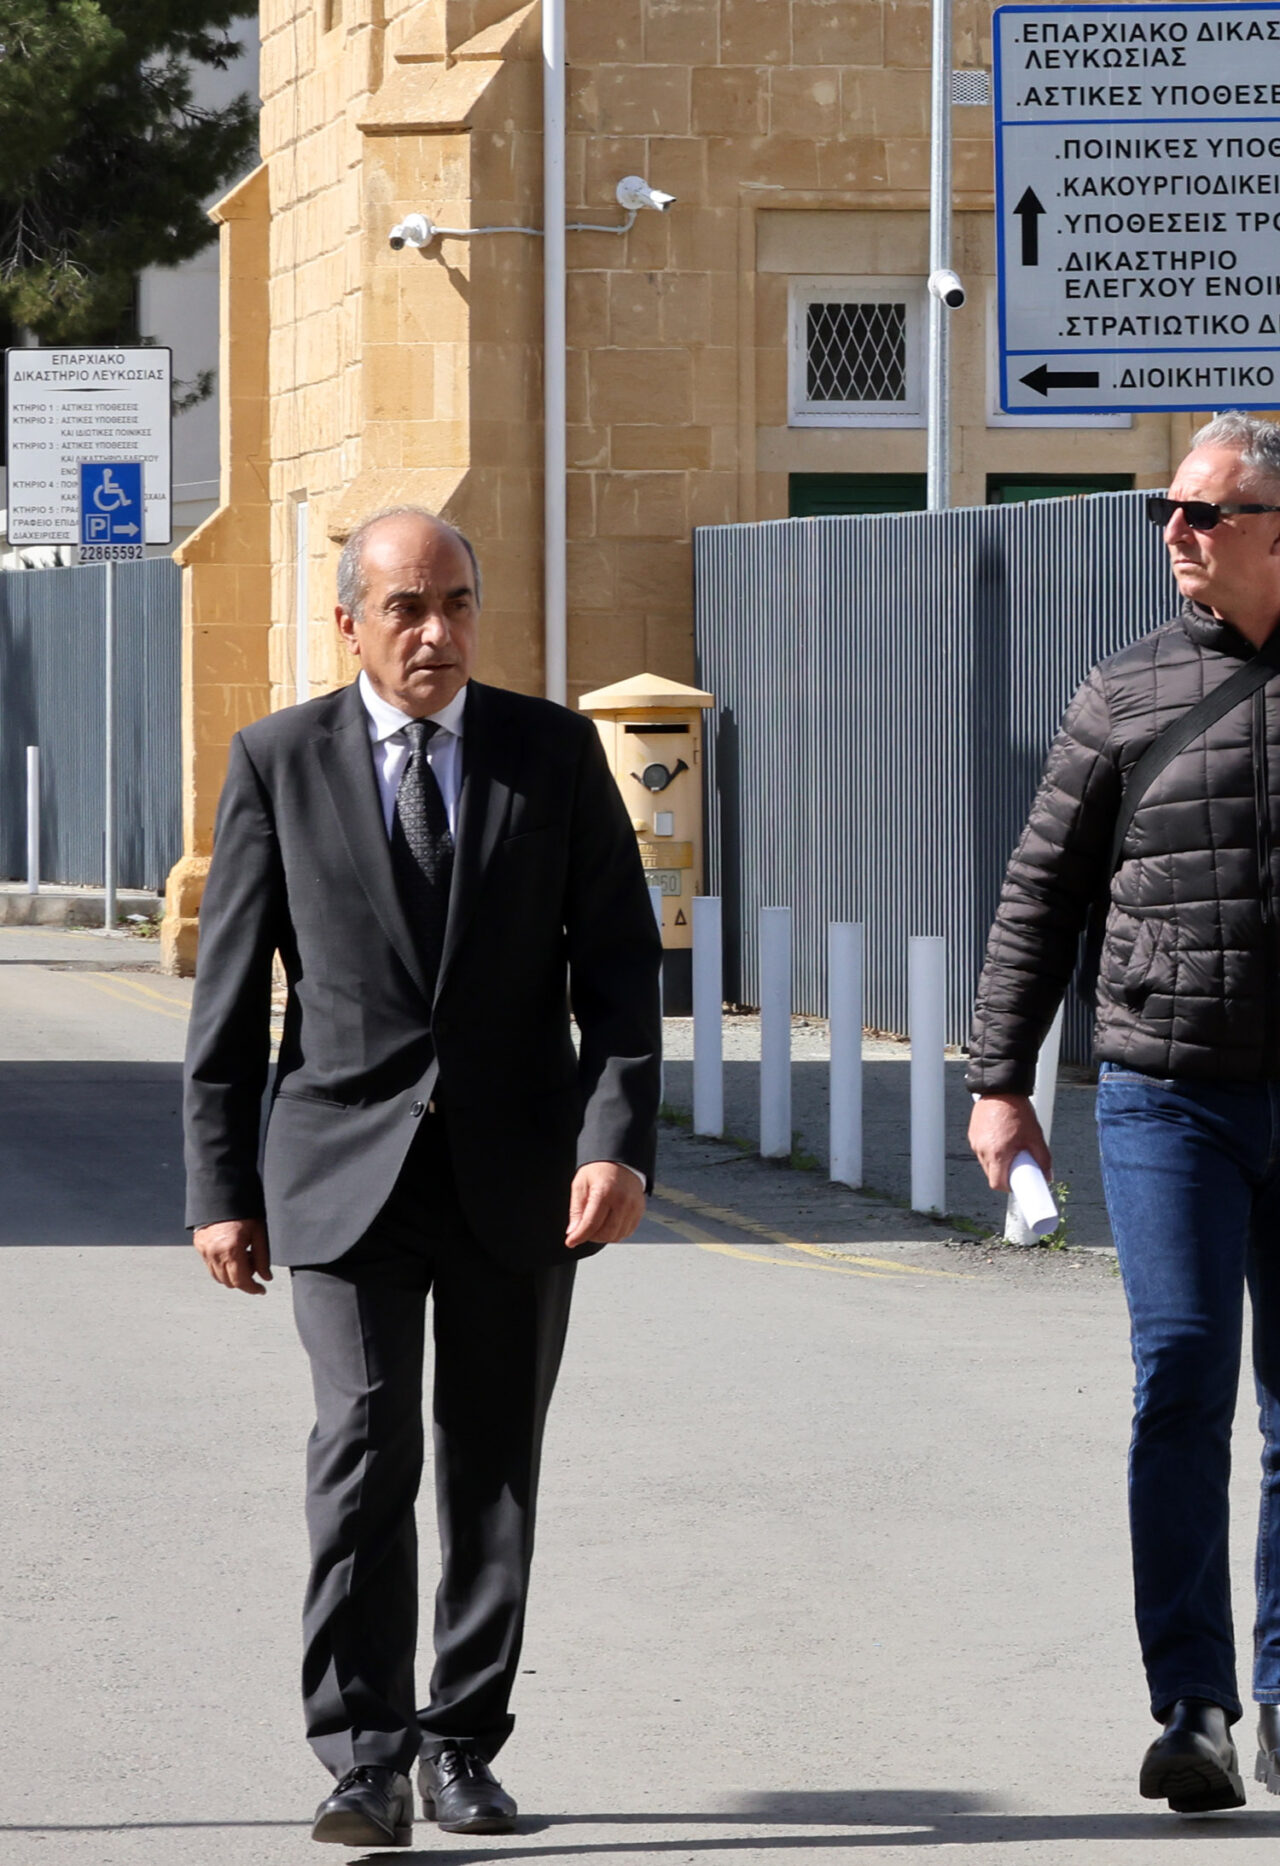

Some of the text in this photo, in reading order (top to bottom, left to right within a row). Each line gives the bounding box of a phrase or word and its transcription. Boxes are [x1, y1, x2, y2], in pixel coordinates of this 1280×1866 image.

[1014, 22, 1188, 43] .ΕΠΑΡΧΙΑΚΟ
[1024, 46, 1187, 69] ΛΕΥΚΩΣΙΑΣ
[1016, 86, 1143, 107] .ΑΣΤΙΚΕΣ
[1057, 212, 1227, 235] .ΥΠΟΘΕΣΕΙΣ
[1057, 250, 1237, 272] .ΔΙΚΑΣΤΗΡΙΟ
[1065, 278, 1196, 299] ΕΛΕΓΧΟΥ
[1058, 315, 1250, 337] .ΣΤΡΑΤΙΩΤΙΚΟ
[52, 354, 125, 365] ΕΠΑΡΧΙΑΚΟ
[14, 369, 164, 381] ΔΙΚΑΣΤΗΡΙΟ ΛΕΥΚΩΣΙΑΣ
[1112, 367, 1275, 389] .ΔΙΟΙΚΗΤΙΚΟ
[13, 416, 46, 424] ΚΤΗΡΙΟ
[13, 506, 46, 514] ΚΤΗΡΙΟ
[90, 518, 107, 538] P
[80, 545, 143, 560] 22865592
